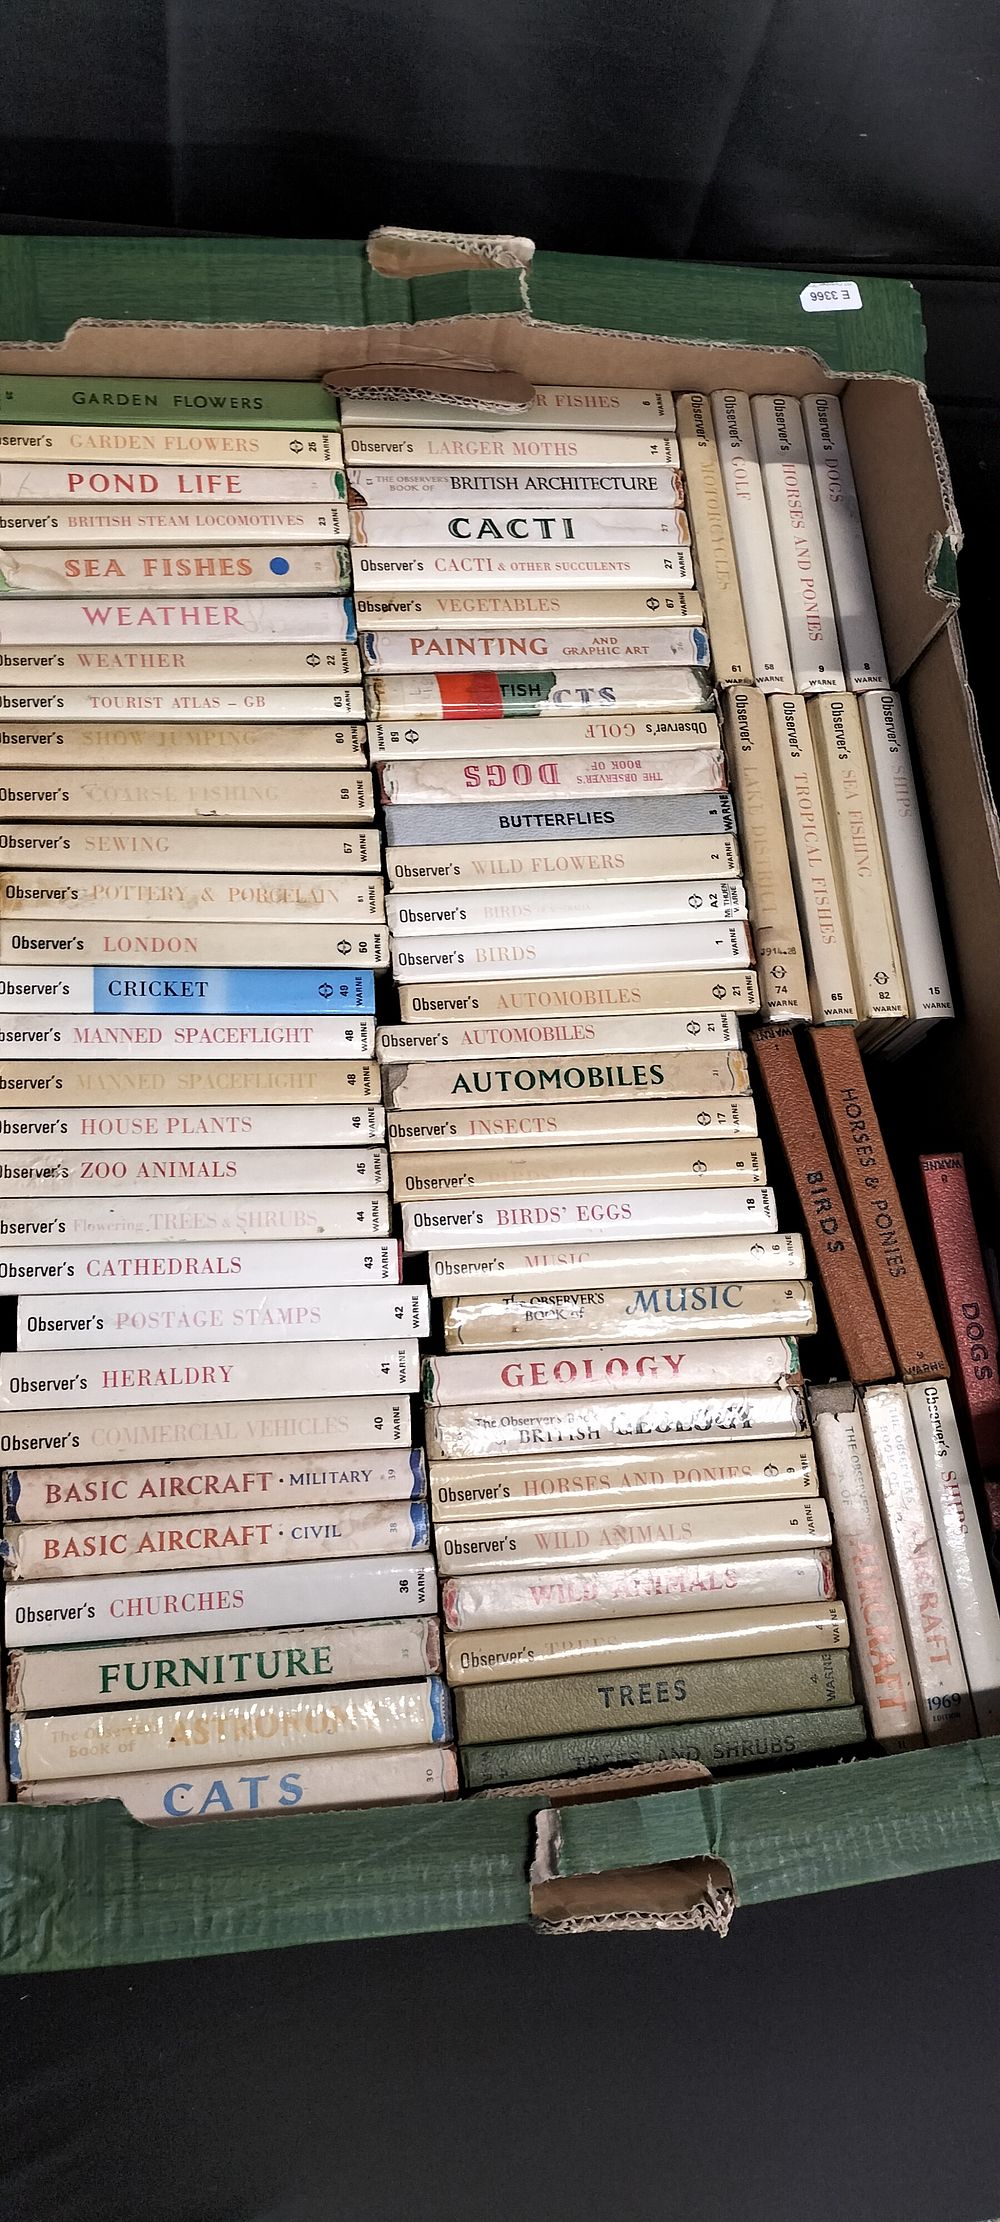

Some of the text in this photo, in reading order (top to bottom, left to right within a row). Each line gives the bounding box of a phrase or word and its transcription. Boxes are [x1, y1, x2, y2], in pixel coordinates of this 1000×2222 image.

[810, 290, 850, 301] E 3366
[72, 391, 263, 410] GARDEN FLOWERS
[555, 394, 620, 408] FISHES
[656, 392, 664, 416] WARNE
[70, 434, 260, 452] GARDEN FLOWERS
[350, 440, 578, 456] Observer's LARGER MOTHS
[724, 395, 752, 502] Observer's GOLF
[815, 398, 844, 503] Observer's DOGS
[68, 473, 242, 494] POND LIFE
[450, 476, 658, 491] BRITISH ARCHITECTURE
[68, 514, 304, 528] BRITISH STEAM LOCOMOTIVES
[448, 517, 576, 540] CACTI
[700, 460, 731, 592] MOTORCYCLES
[773, 398, 824, 642] Observer's HORSES AND PONIES
[64, 558, 254, 578] SEA FISHES
[434, 558, 630, 573] CACTI OTHER SUCCULENTS
[664, 558, 672, 570] 27
[357, 598, 560, 613] Observer's VEGETABLES
[678, 592, 688, 616] WARNE
[81, 606, 244, 626] WEATHER
[410, 636, 549, 656] PAINTING
[562, 644, 650, 656] GRAPHIC ART
[592, 636, 618, 645] AND
[76, 653, 186, 668] WEATHER
[326, 654, 336, 666] 22
[341, 648, 350, 674] WARNE
[732, 664, 742, 672] 61
[854, 676, 883, 684] WARNE
[90, 696, 266, 710] TOURIST ATLAS GB
[585, 722, 707, 738] Observer's GOLF
[612, 760, 642, 770] BOOK
[881, 696, 912, 819] Observer's SHIPS
[464, 762, 560, 788] DOGS
[576, 772, 663, 784] THE OBSERVER'S
[188, 784, 278, 802] FISHING
[830, 702, 872, 878] Observer's SEA FISHING
[499, 811, 615, 829] BUTTERFLIES
[782, 701, 836, 946] Observer's TROPICAL FISHES
[84, 836, 170, 852] SEWING
[394, 854, 625, 878] Observer's WILD FLOWERS
[6, 884, 340, 904] Observer's POTTERY & PORCELAIN
[710, 892, 718, 908] A2
[484, 904, 532, 919] BIRDS
[12, 935, 198, 953] Observer's LONDON
[731, 927, 740, 957] WARNE
[398, 945, 536, 967] Observer's BIRDS
[108, 980, 208, 998] CRICKET
[339, 984, 348, 997] 49
[732, 985, 740, 997] 21
[830, 992, 843, 1001] 65
[878, 990, 891, 1000] 82
[412, 988, 642, 1012] Observer's AUTOMOBILES
[872, 1004, 902, 1013] WARNE
[72, 1026, 314, 1044] MANNED SPACEFLIGHT
[380, 1024, 596, 1048] Observer's AUTOMOBILES
[76, 1072, 316, 1090] MANNED SPACEFLIGHT
[347, 1074, 356, 1086] 48
[450, 1064, 664, 1096] AUTOMOBILES
[80, 1116, 252, 1136] HOUSE PLANTS
[468, 1116, 558, 1137] INSECTS
[80, 1160, 238, 1179] ZOO ANIMALS
[356, 1162, 366, 1174] 45
[374, 1152, 382, 1184] WARNE
[840, 1088, 907, 1280] HORSES PONIES
[149, 1210, 318, 1230] TREES SHRUBS
[414, 1203, 632, 1229] Observer's BIRDS' EGGS
[804, 1170, 846, 1254] BIRDS
[86, 1256, 242, 1278] CATHEDRALS
[364, 1256, 374, 1269] 43
[625, 1284, 744, 1316] MUSIC
[26, 1307, 322, 1332] Observer's POSTAGE STAMPS
[394, 1306, 404, 1320] 42
[411, 1294, 420, 1329] WARNE
[960, 1302, 993, 1382] DOGS
[102, 1365, 234, 1389] HERALDRY
[500, 1353, 686, 1389] GEOLOGY
[374, 1416, 384, 1431] 40
[0, 1416, 350, 1452] Observer's COMMERCIAL VEHICLES
[45, 1470, 374, 1505] BASIC AIRCRAFT MILITARY
[438, 1474, 612, 1503] Observer's HORSES
[43, 1523, 342, 1560] BASIC AIRCRAFT CIVIL
[444, 1522, 694, 1556] Observer's WILD ANIMALS
[400, 1579, 410, 1594] 36
[15, 1590, 244, 1624] Observer's CHURCHES
[98, 1646, 334, 1694] FURNITURE
[598, 1678, 688, 1708] TREES
[926, 1692, 962, 1712] 1969
[162, 1773, 304, 1817] CATS
